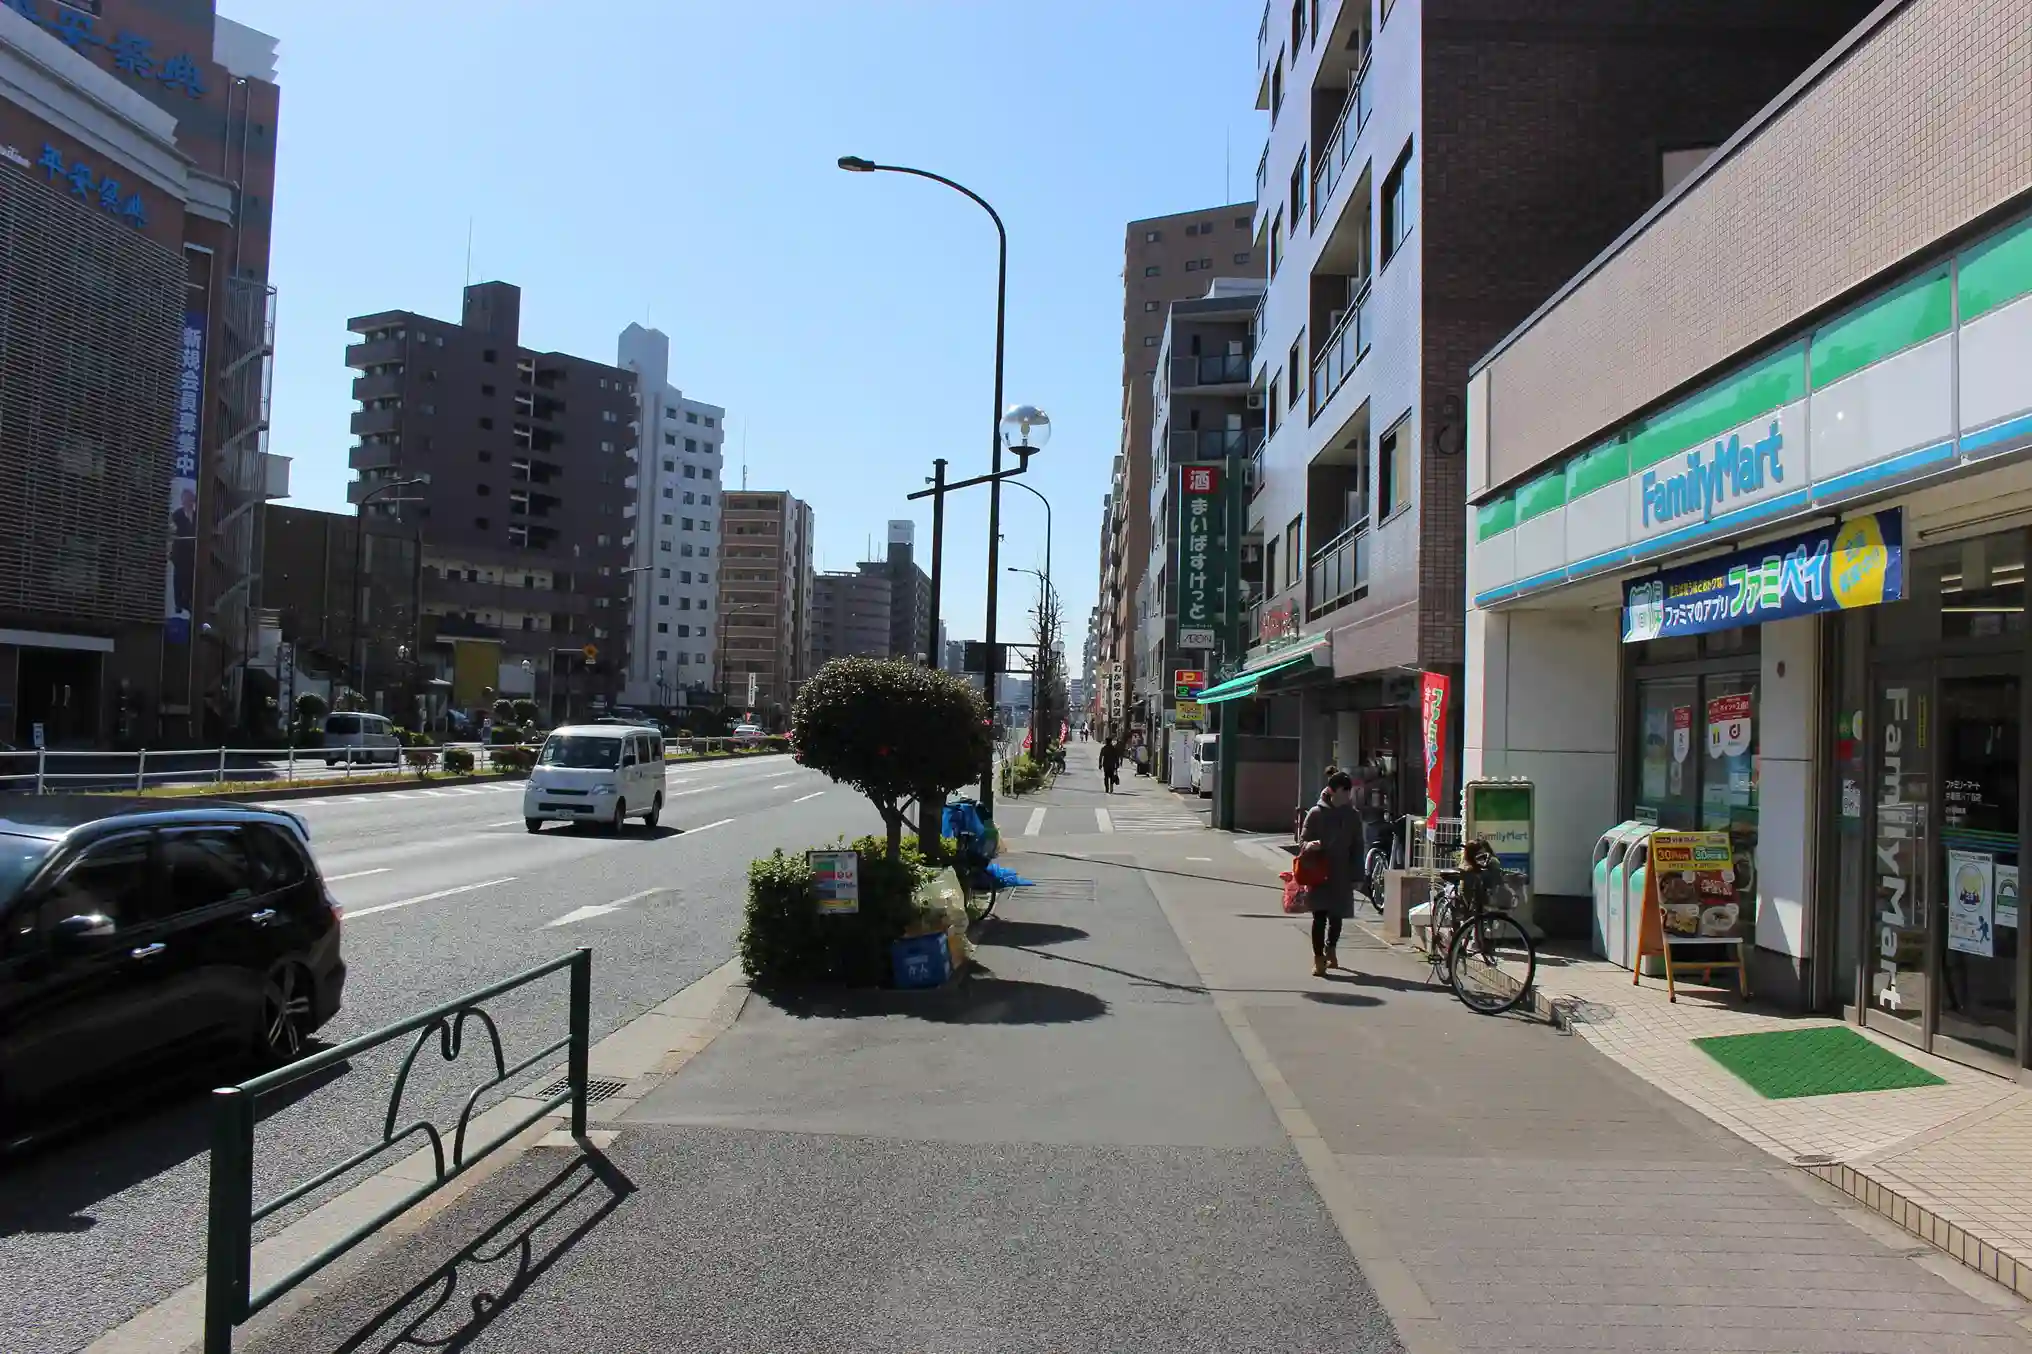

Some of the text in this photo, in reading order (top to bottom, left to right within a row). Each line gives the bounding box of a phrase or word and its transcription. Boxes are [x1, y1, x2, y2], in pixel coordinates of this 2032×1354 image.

[37, 142, 148, 229] 平安祭典
[175, 327, 201, 476] 新規会員募集中
[1189, 469, 1211, 491] 酒
[1642, 420, 1784, 529] FamilyMart
[1189, 498, 1208, 621] まいばすけっと
[1729, 539, 1830, 618] ファミペイ
[1664, 594, 1729, 627] ファミマのアプリ
[1476, 830, 1528, 843] FamilyMart
[1877, 687, 1909, 1012] FamilyMart
